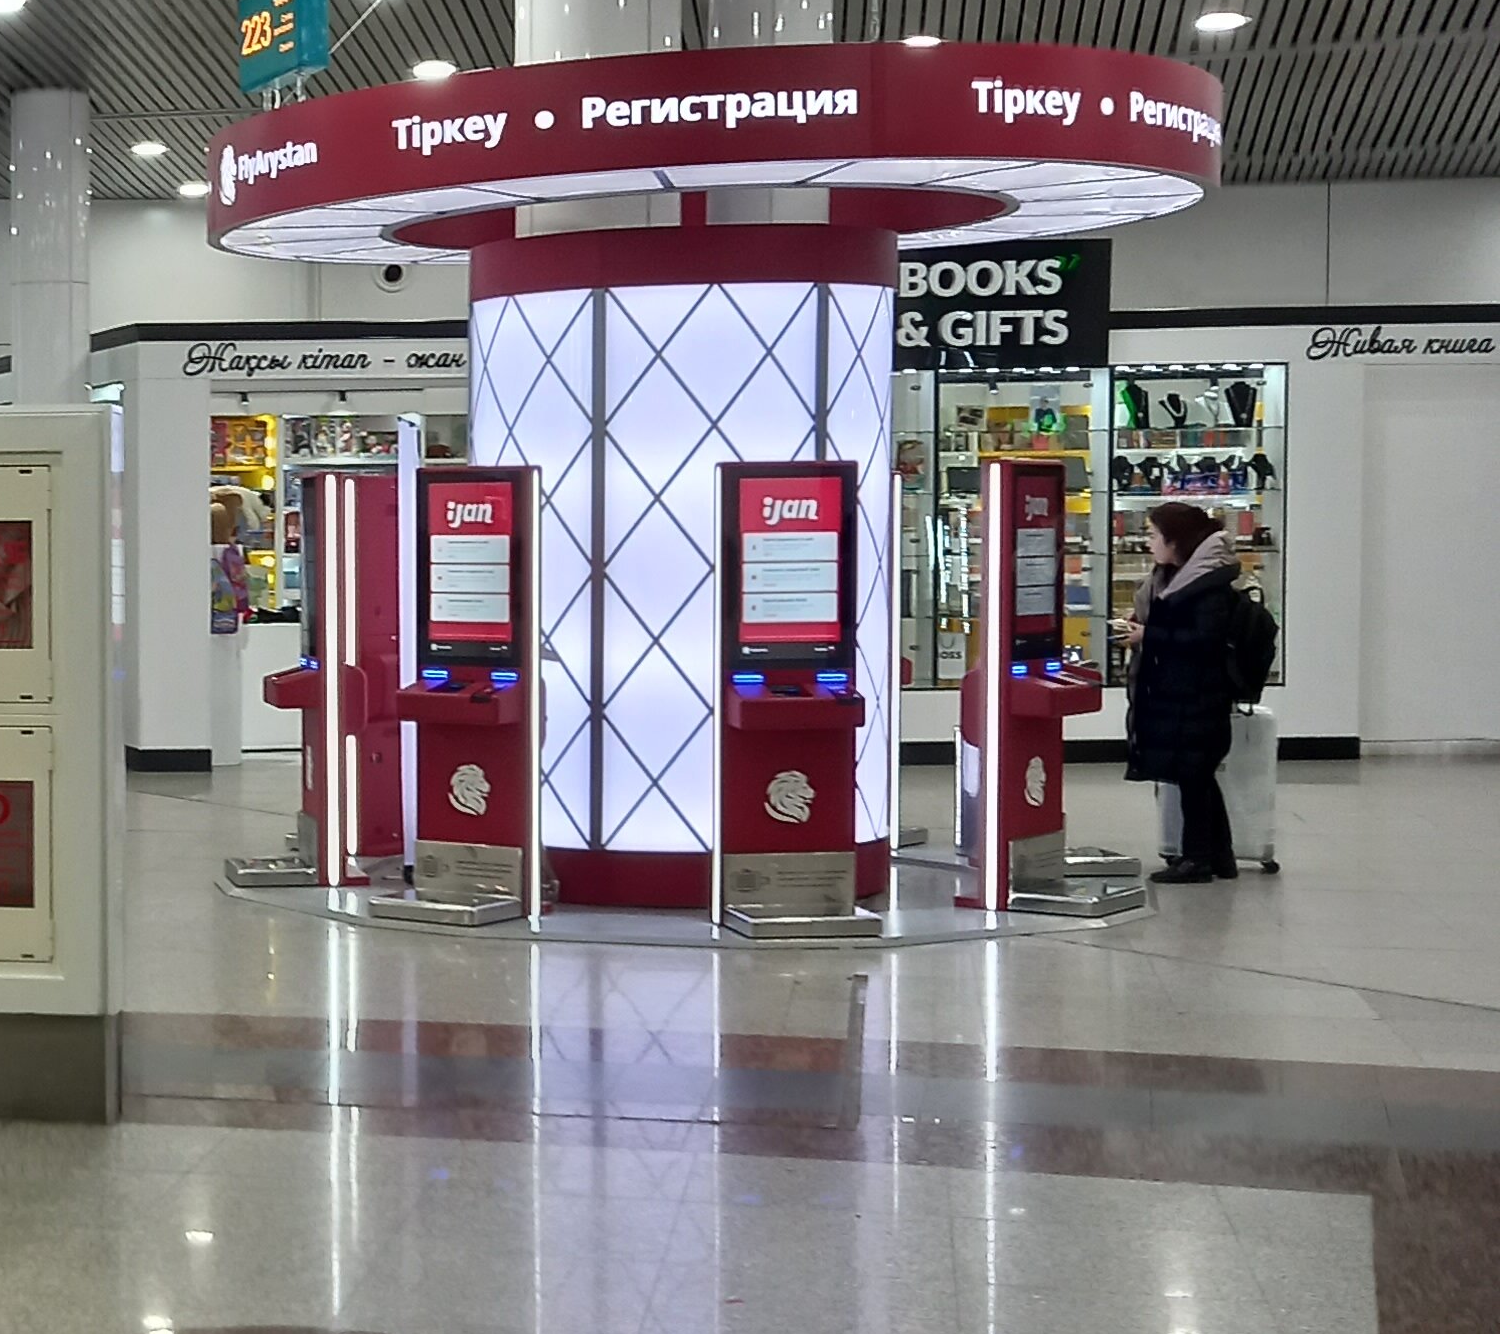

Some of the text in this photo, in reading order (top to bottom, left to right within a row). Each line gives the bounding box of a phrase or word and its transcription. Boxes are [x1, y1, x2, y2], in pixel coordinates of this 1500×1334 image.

[240, 11, 272, 56] 223
[392, 88, 859, 156] Тіркеу Регистрация
[971, 77, 1082, 125] Тіркеу
[237, 140, 318, 185] FlyArystan
[898, 258, 1063, 298] BOOKS
[897, 309, 1070, 347] & GIFTS
[1306, 326, 1496, 360] Живая книга
[183, 342, 292, 376] Жақсы
[296, 348, 372, 372] кітап
